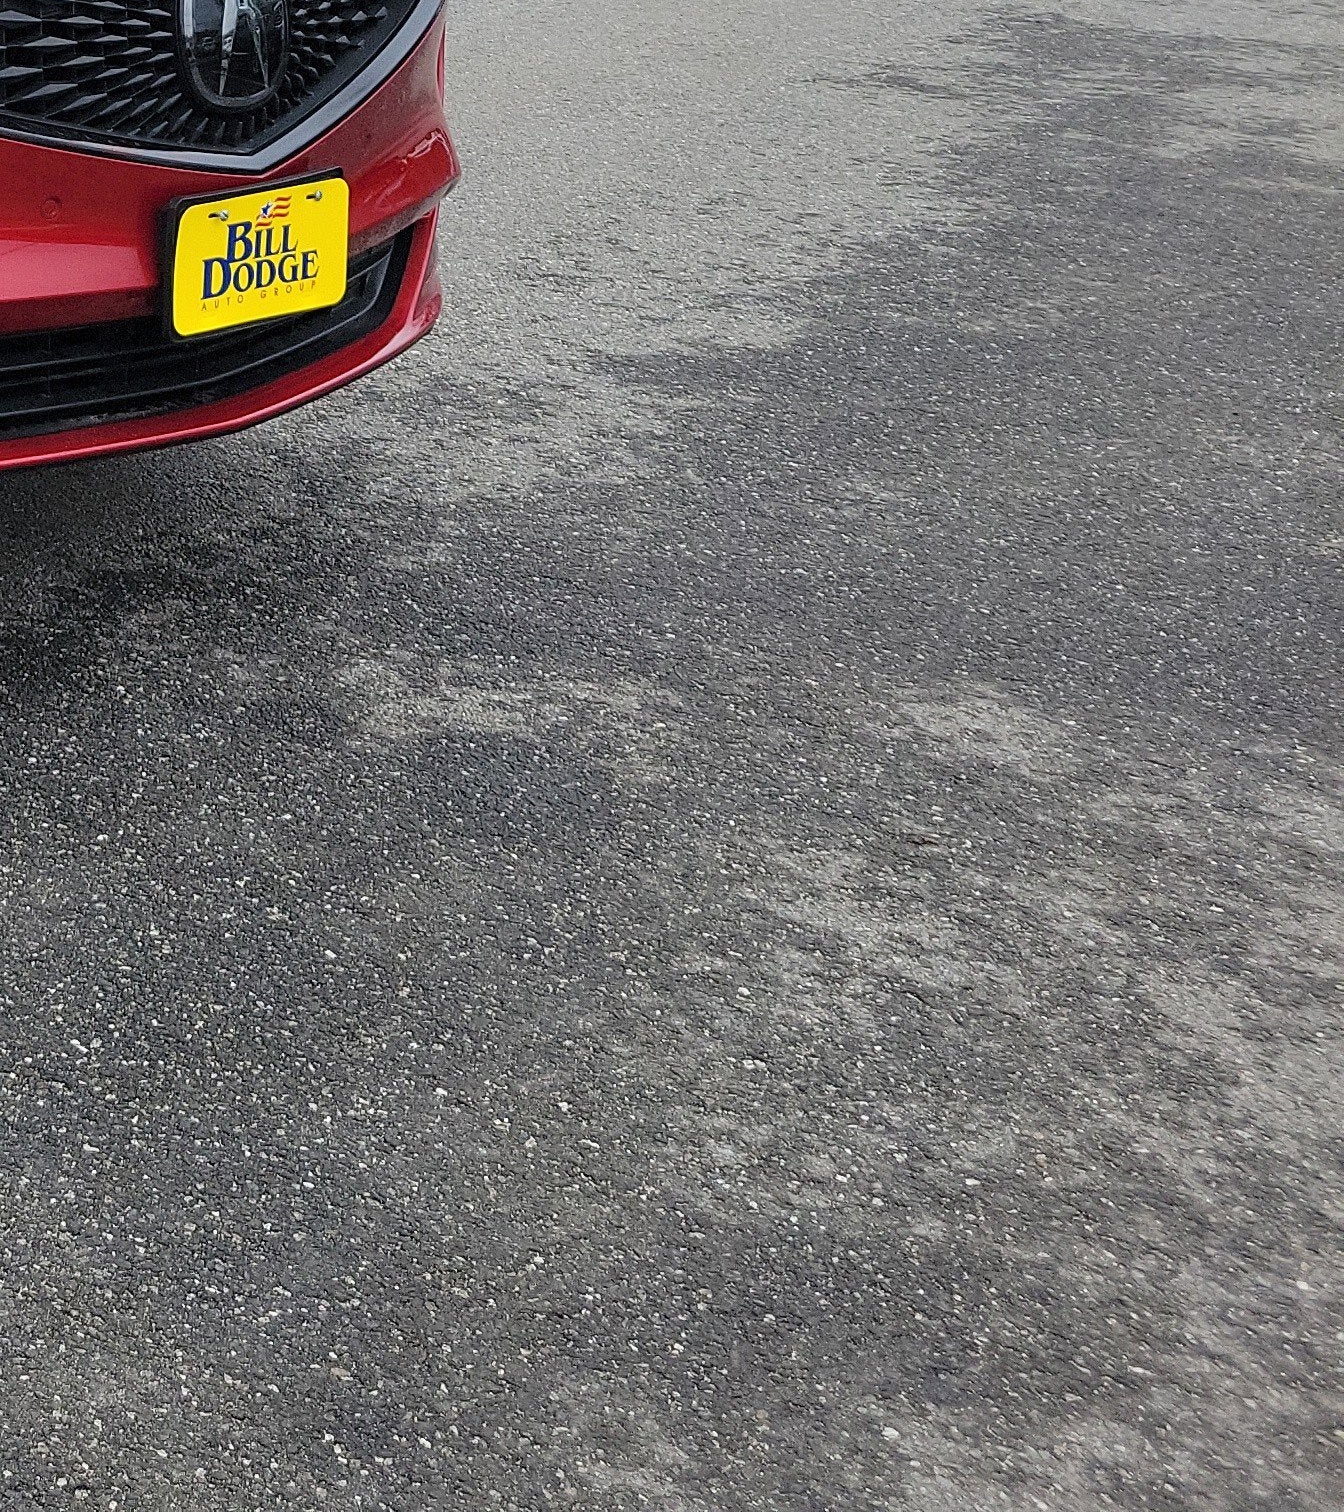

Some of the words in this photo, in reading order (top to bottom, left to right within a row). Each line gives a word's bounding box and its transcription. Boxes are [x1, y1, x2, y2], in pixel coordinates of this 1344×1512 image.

[226, 221, 299, 263] BILL
[200, 249, 319, 300] DODGE
[201, 294, 245, 311] AUTO
[260, 280, 317, 299] GROUP
